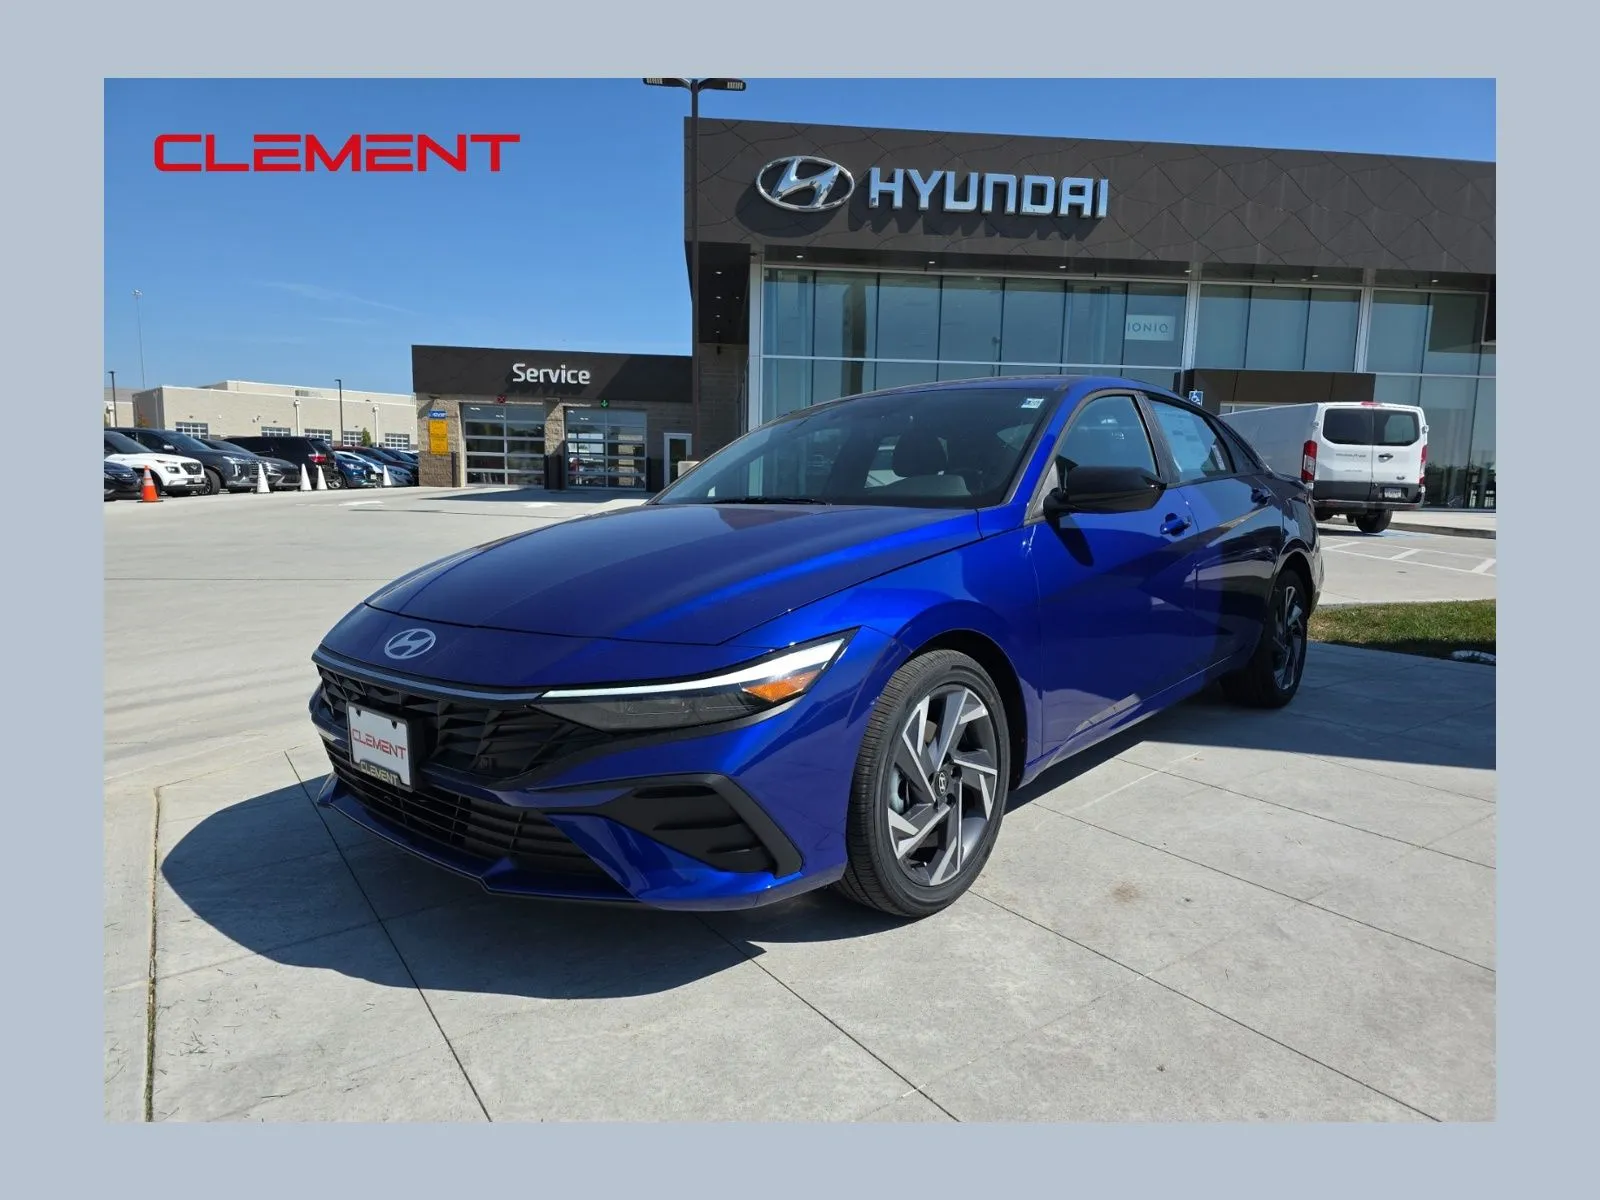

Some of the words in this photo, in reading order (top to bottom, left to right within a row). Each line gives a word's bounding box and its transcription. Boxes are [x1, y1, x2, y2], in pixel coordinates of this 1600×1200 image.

[869, 167, 1109, 218] HYUNDAI
[1127, 322, 1168, 334] IONIQ
[512, 363, 591, 385] Service
[352, 728, 406, 760] CLEMENT
[360, 761, 398, 786] CLEMENT
